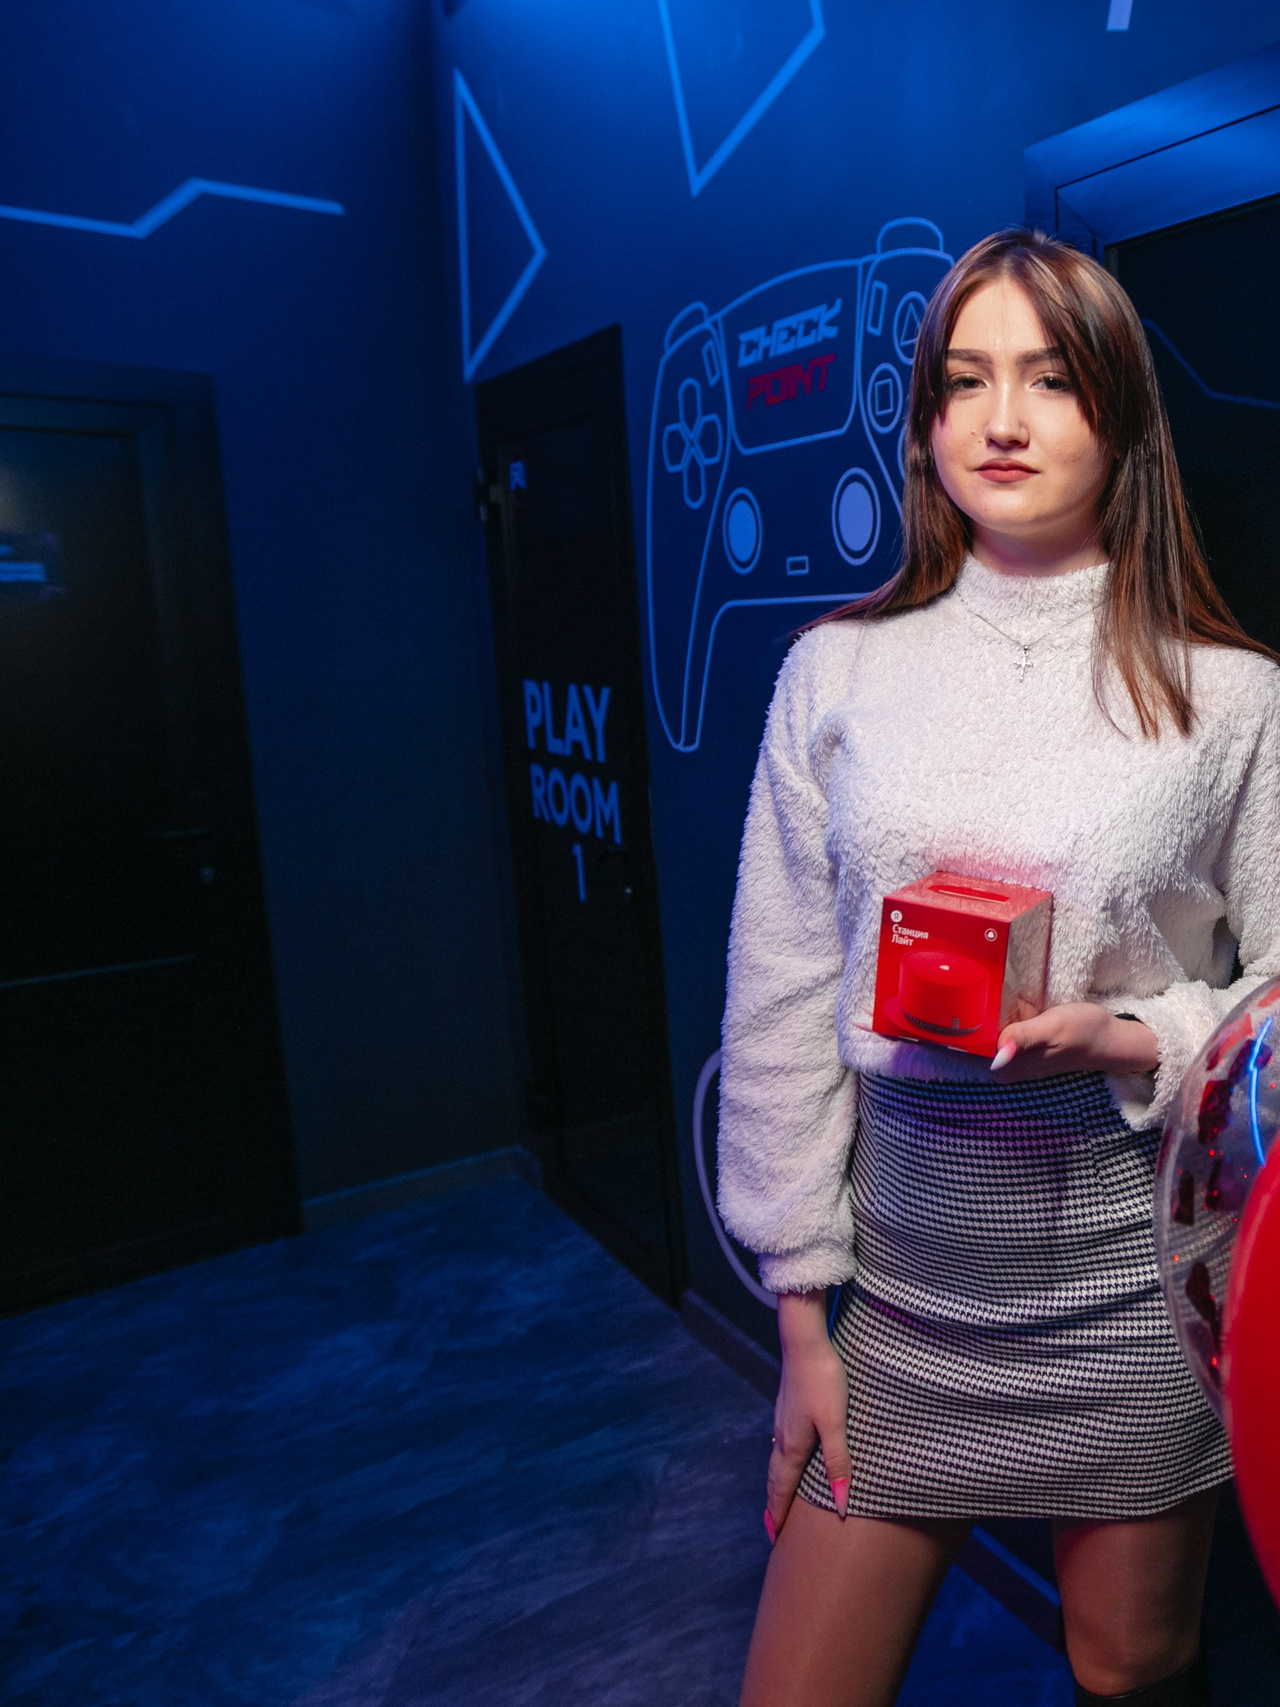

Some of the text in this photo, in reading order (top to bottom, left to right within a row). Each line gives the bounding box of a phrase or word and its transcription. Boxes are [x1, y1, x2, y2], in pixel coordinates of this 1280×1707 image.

[737, 298, 842, 367] CHECK
[747, 353, 835, 410] POINT
[523, 679, 611, 763] PLAY
[529, 763, 622, 845] ROOM
[571, 842, 587, 902] 1
[891, 933, 914, 946] Лайт
[892, 923, 929, 940] Станция
